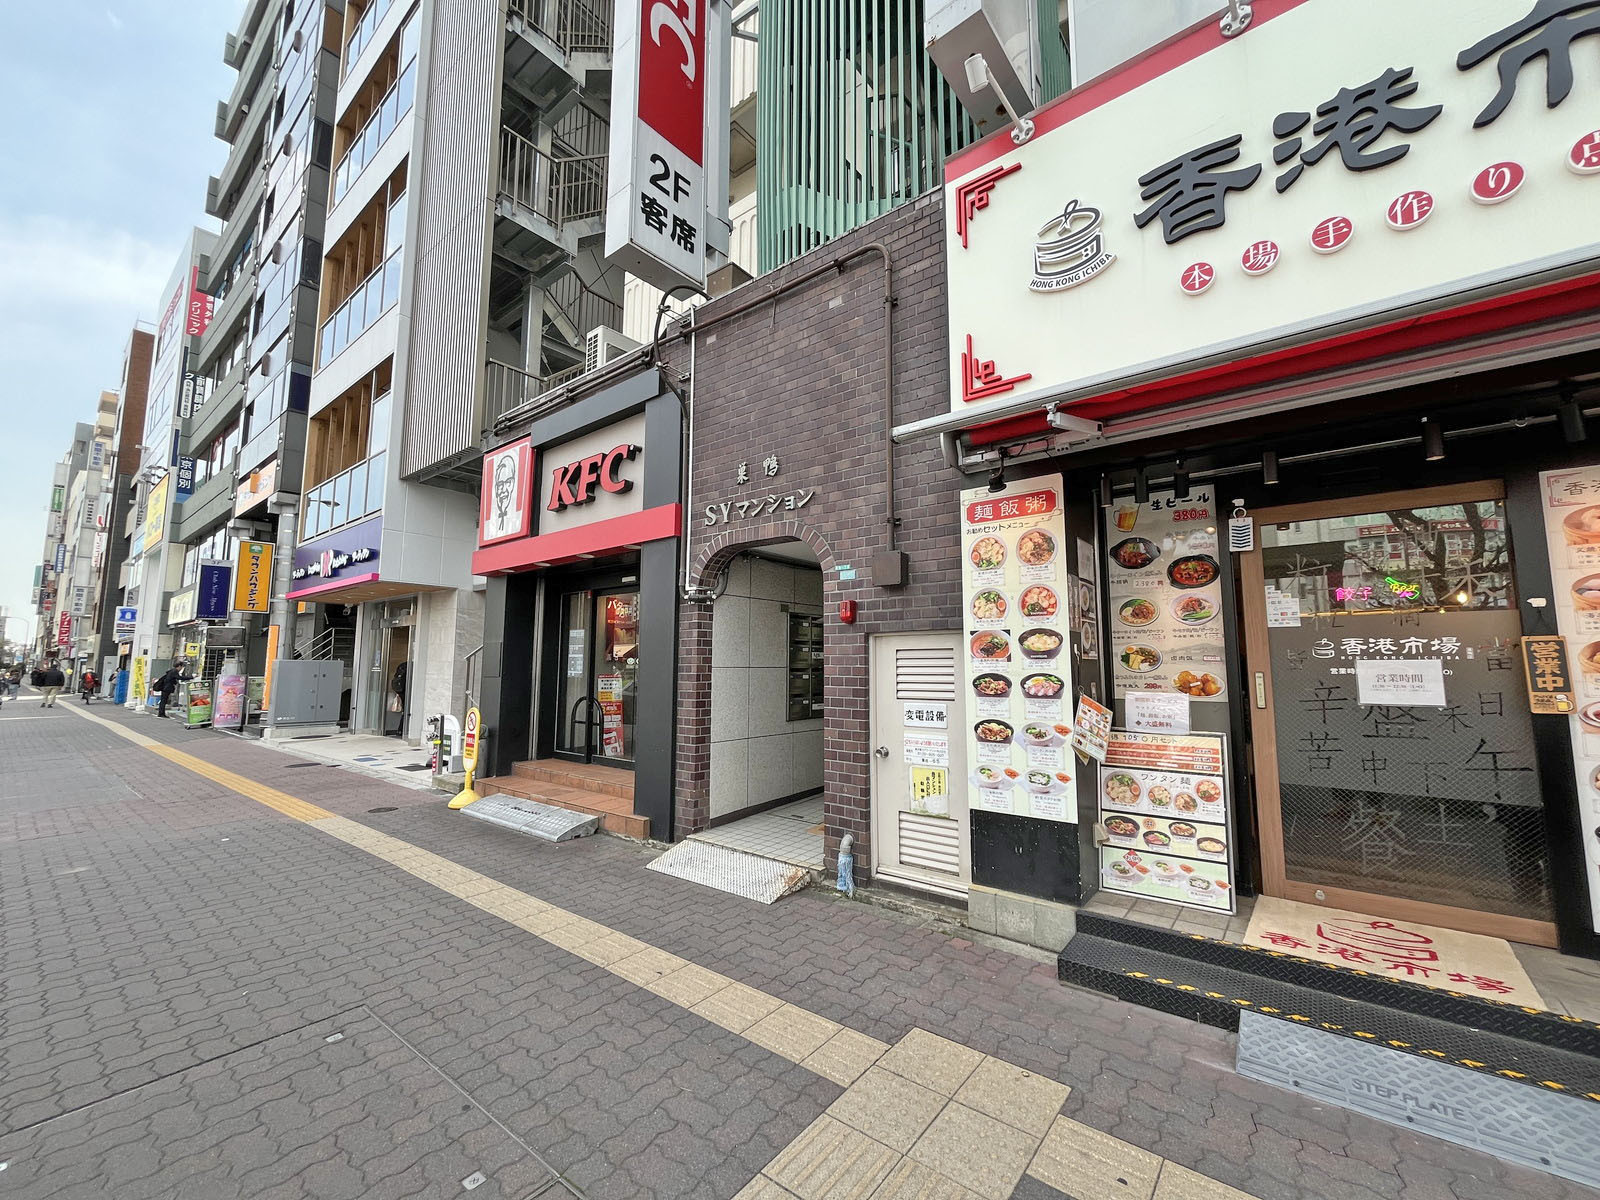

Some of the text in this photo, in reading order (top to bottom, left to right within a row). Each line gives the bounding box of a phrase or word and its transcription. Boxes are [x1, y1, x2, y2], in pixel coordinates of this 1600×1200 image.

[650, 153, 691, 203] 2F
[640, 192, 697, 254] 客席
[1030, 253, 1112, 288] HONG KONG ICHIBA
[548, 444, 631, 512] KFC
[736, 455, 780, 485] 巣鴨
[704, 488, 816, 527] SYマンション
[974, 494, 1047, 521] 麺飯粥
[1151, 493, 1209, 511] 生ビール
[1340, 636, 1462, 655] 香港市場
[1530, 641, 1565, 691] 営業中
[1260, 930, 1515, 994] 香港市場
[1352, 1078, 1468, 1121] STEP PLATE
